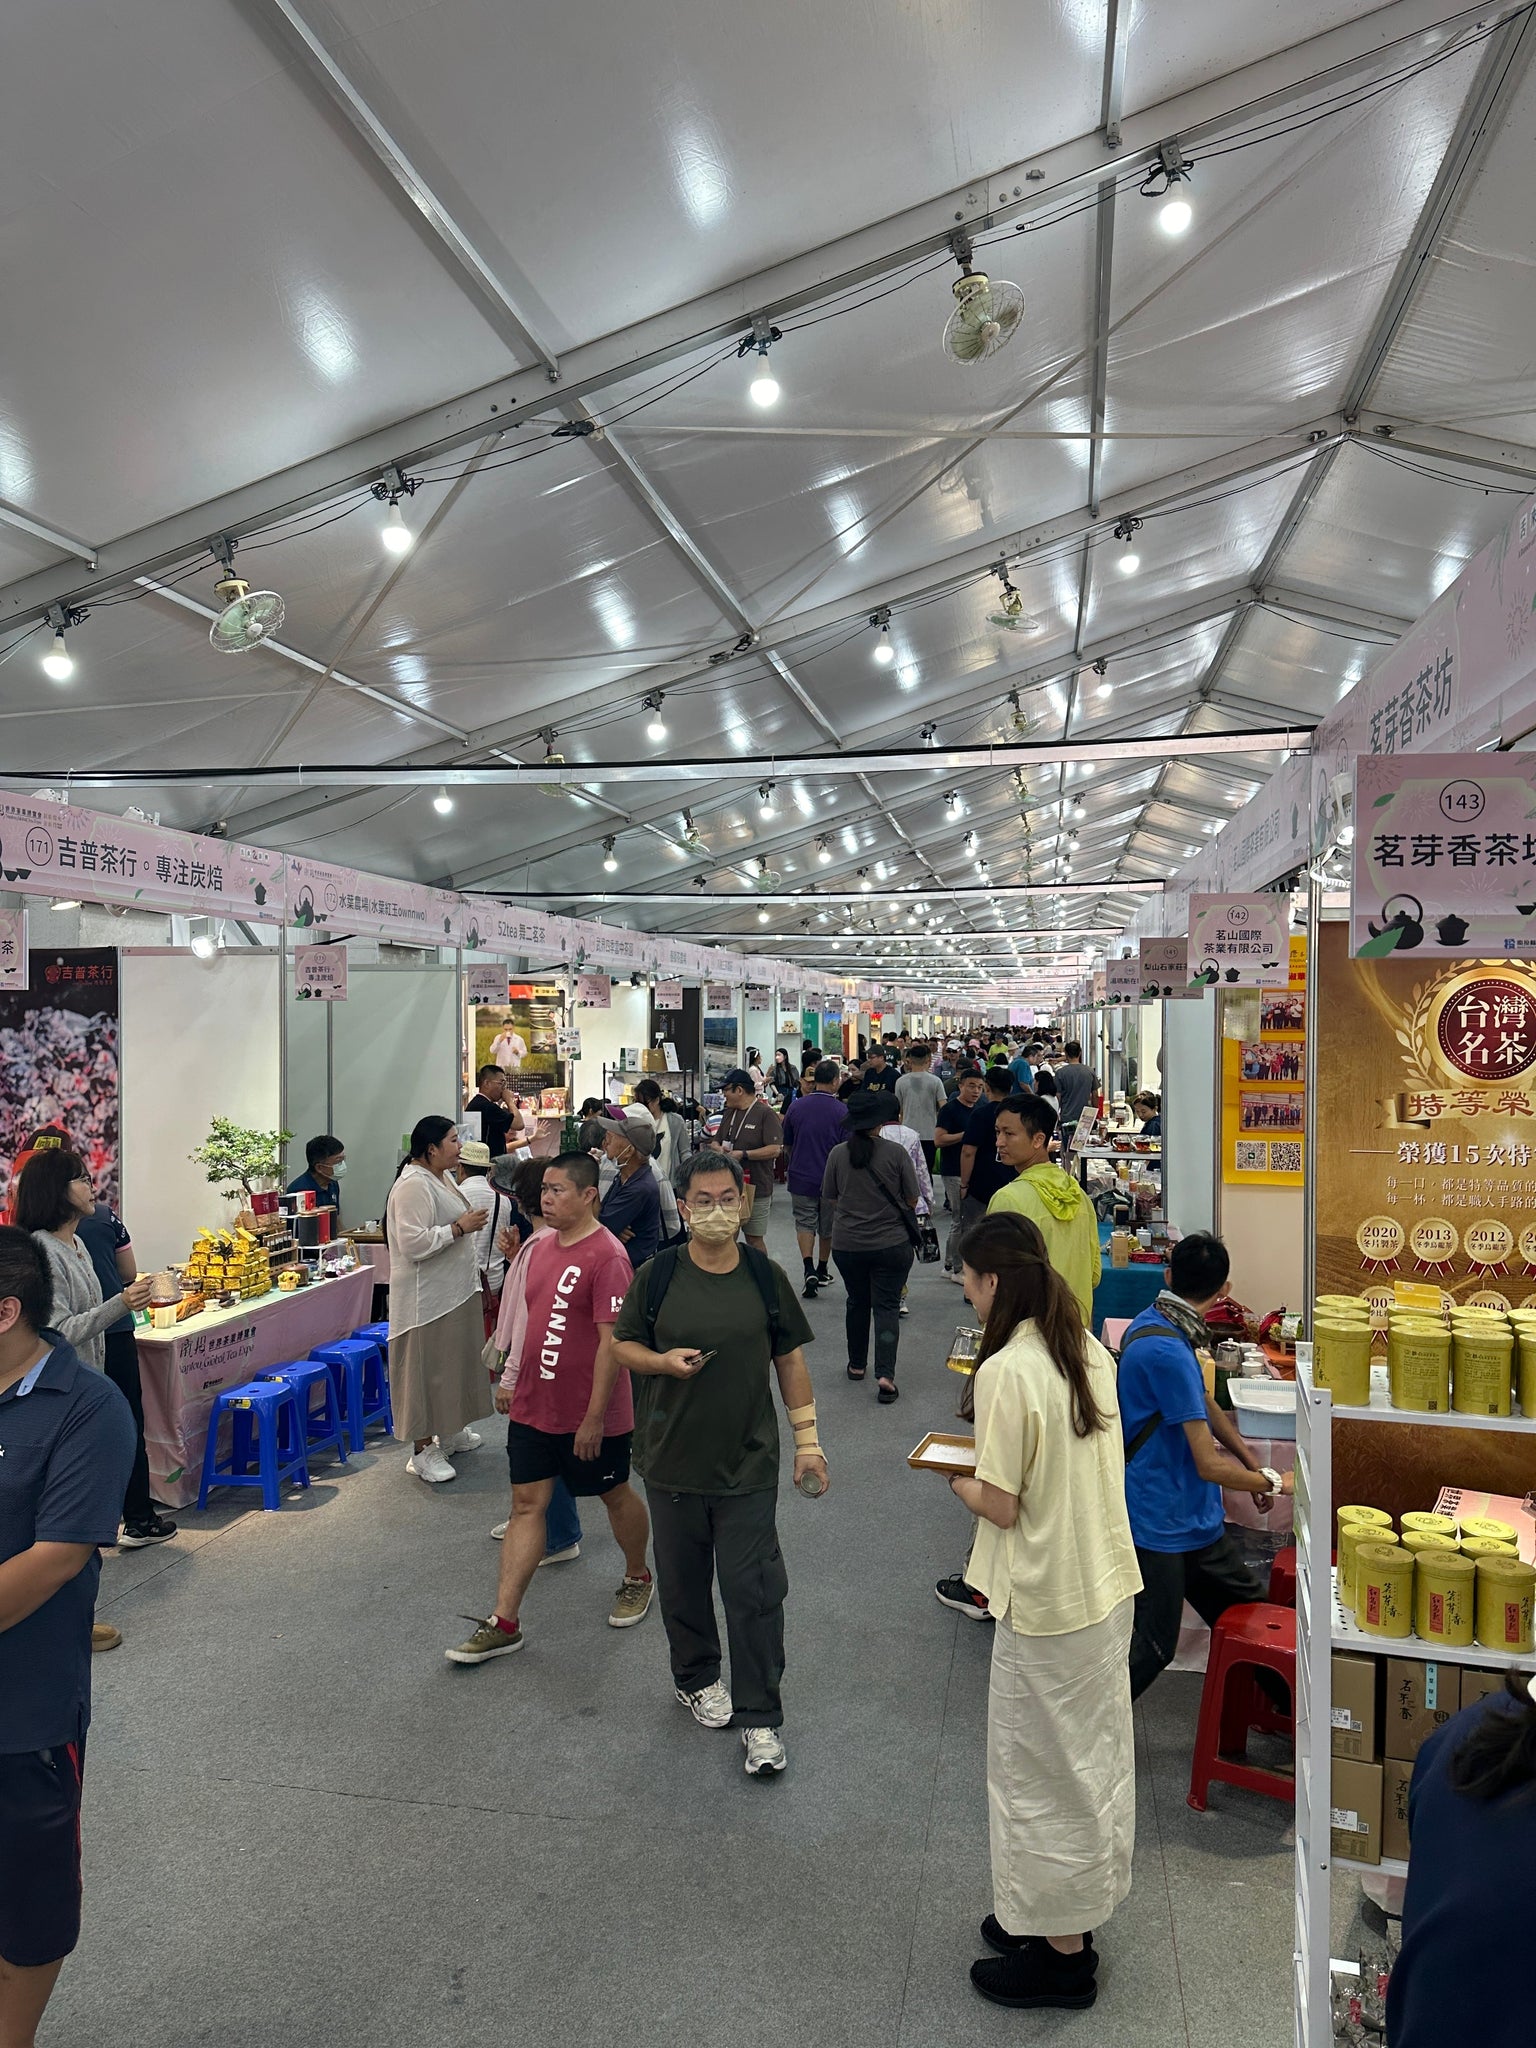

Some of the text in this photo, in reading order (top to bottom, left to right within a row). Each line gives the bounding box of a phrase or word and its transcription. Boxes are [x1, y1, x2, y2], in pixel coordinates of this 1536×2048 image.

[1370, 647, 1453, 755] 茗芽香茶坊
[1444, 794, 1480, 810] 143
[29, 839, 49, 853] 171
[1230, 910, 1246, 920] 142
[1216, 930, 1262, 941] 茗山國際
[1204, 943, 1273, 954] 茶業有限公司
[61, 965, 113, 980] 吉普茶行
[1457, 995, 1529, 1029] 台灣
[1457, 1031, 1529, 1065] 名茶
[1408, 1090, 1535, 1117] 特等榮
[1397, 1141, 1536, 1168] 榮獲15次特
[1363, 1226, 1398, 1239] 2020
[1417, 1228, 1451, 1241] 2013
[1470, 1230, 1506, 1243] 2012
[1363, 1239, 1399, 1249] 冬片製茶
[539, 1265, 582, 1381] CANADA
[226, 1348, 238, 1361] Tea
